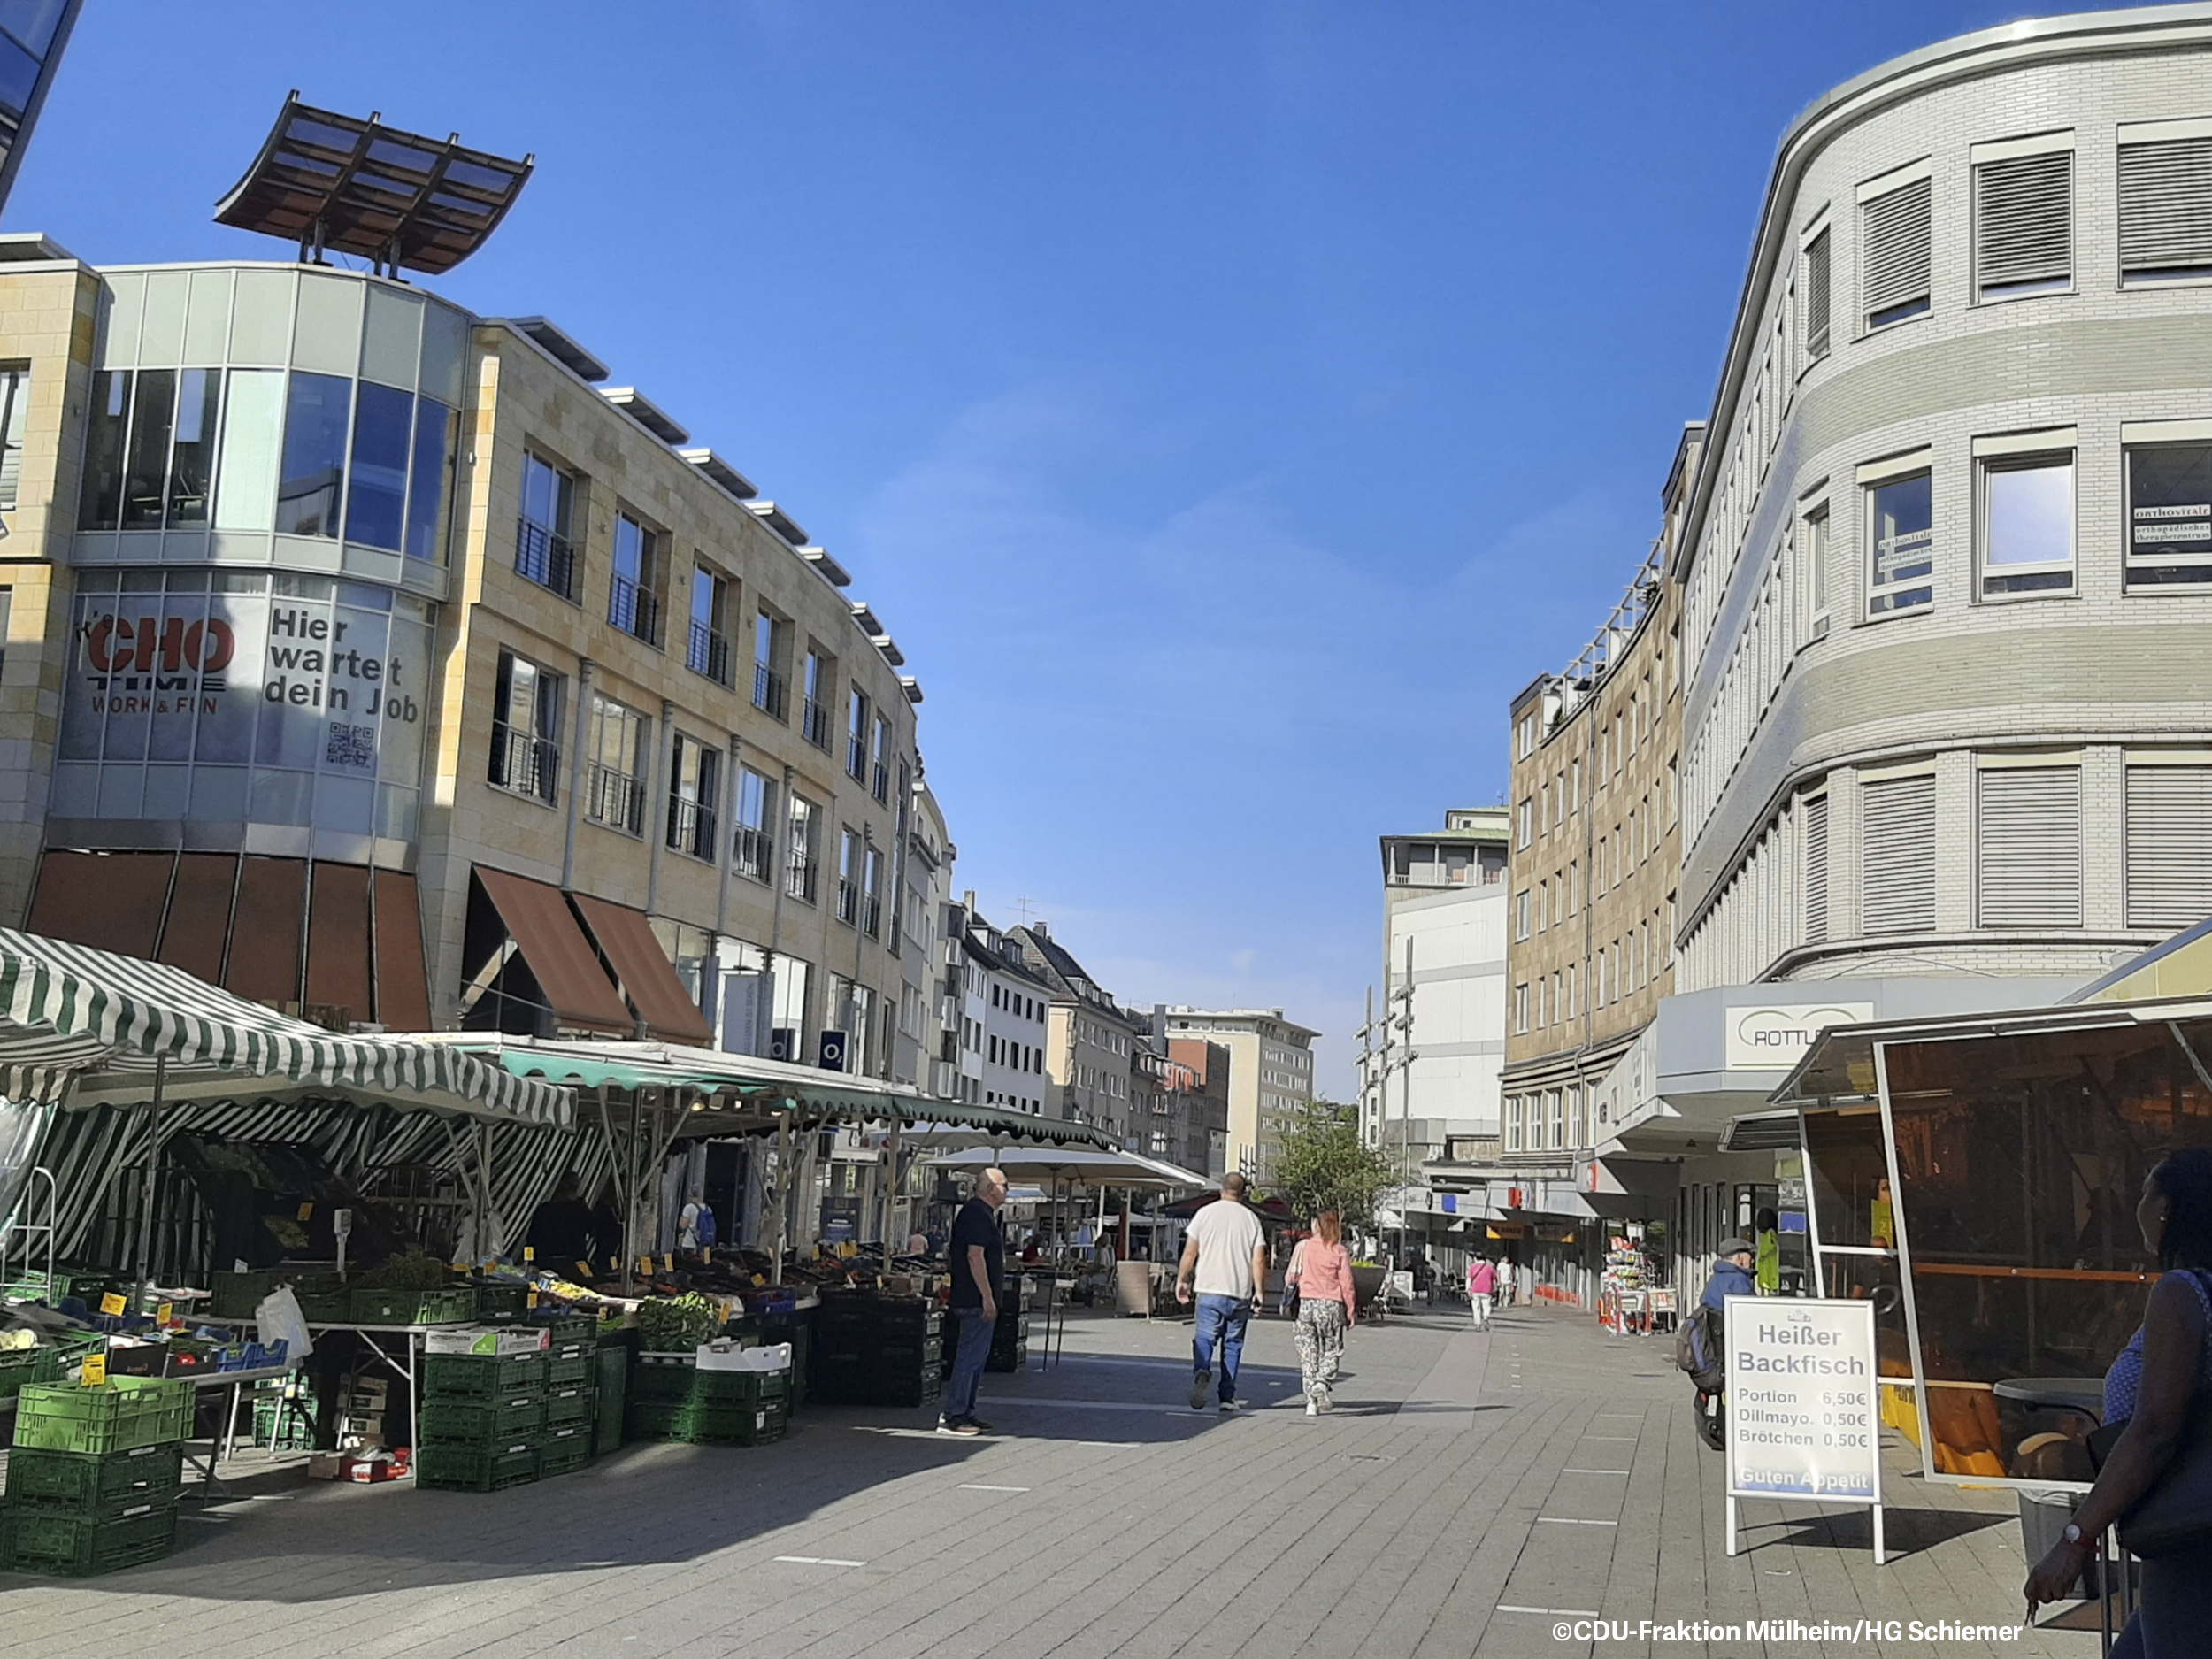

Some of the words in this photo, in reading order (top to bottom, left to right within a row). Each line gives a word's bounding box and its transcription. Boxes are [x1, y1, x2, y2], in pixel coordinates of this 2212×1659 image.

[272, 608, 348, 642] Hier
[88, 618, 235, 672] CHO
[271, 645, 402, 686] wartet
[87, 677, 226, 692] TIME
[92, 696, 151, 714] WORK
[157, 700, 168, 713] &
[265, 675, 349, 710] dein
[365, 688, 418, 723] Job
[1758, 1325, 1841, 1346] Heißer
[1738, 1352, 1864, 1375] Backfisch
[1739, 1388, 1797, 1403] Portion
[1822, 1392, 1866, 1406] 6,50€
[1739, 1409, 1814, 1427] Dillmayo.
[1823, 1413, 1867, 1427] 0,50€
[1739, 1430, 1814, 1446] Brötchen
[1824, 1434, 1868, 1448] 0,50€
[1740, 1468, 1795, 1485] Guten
